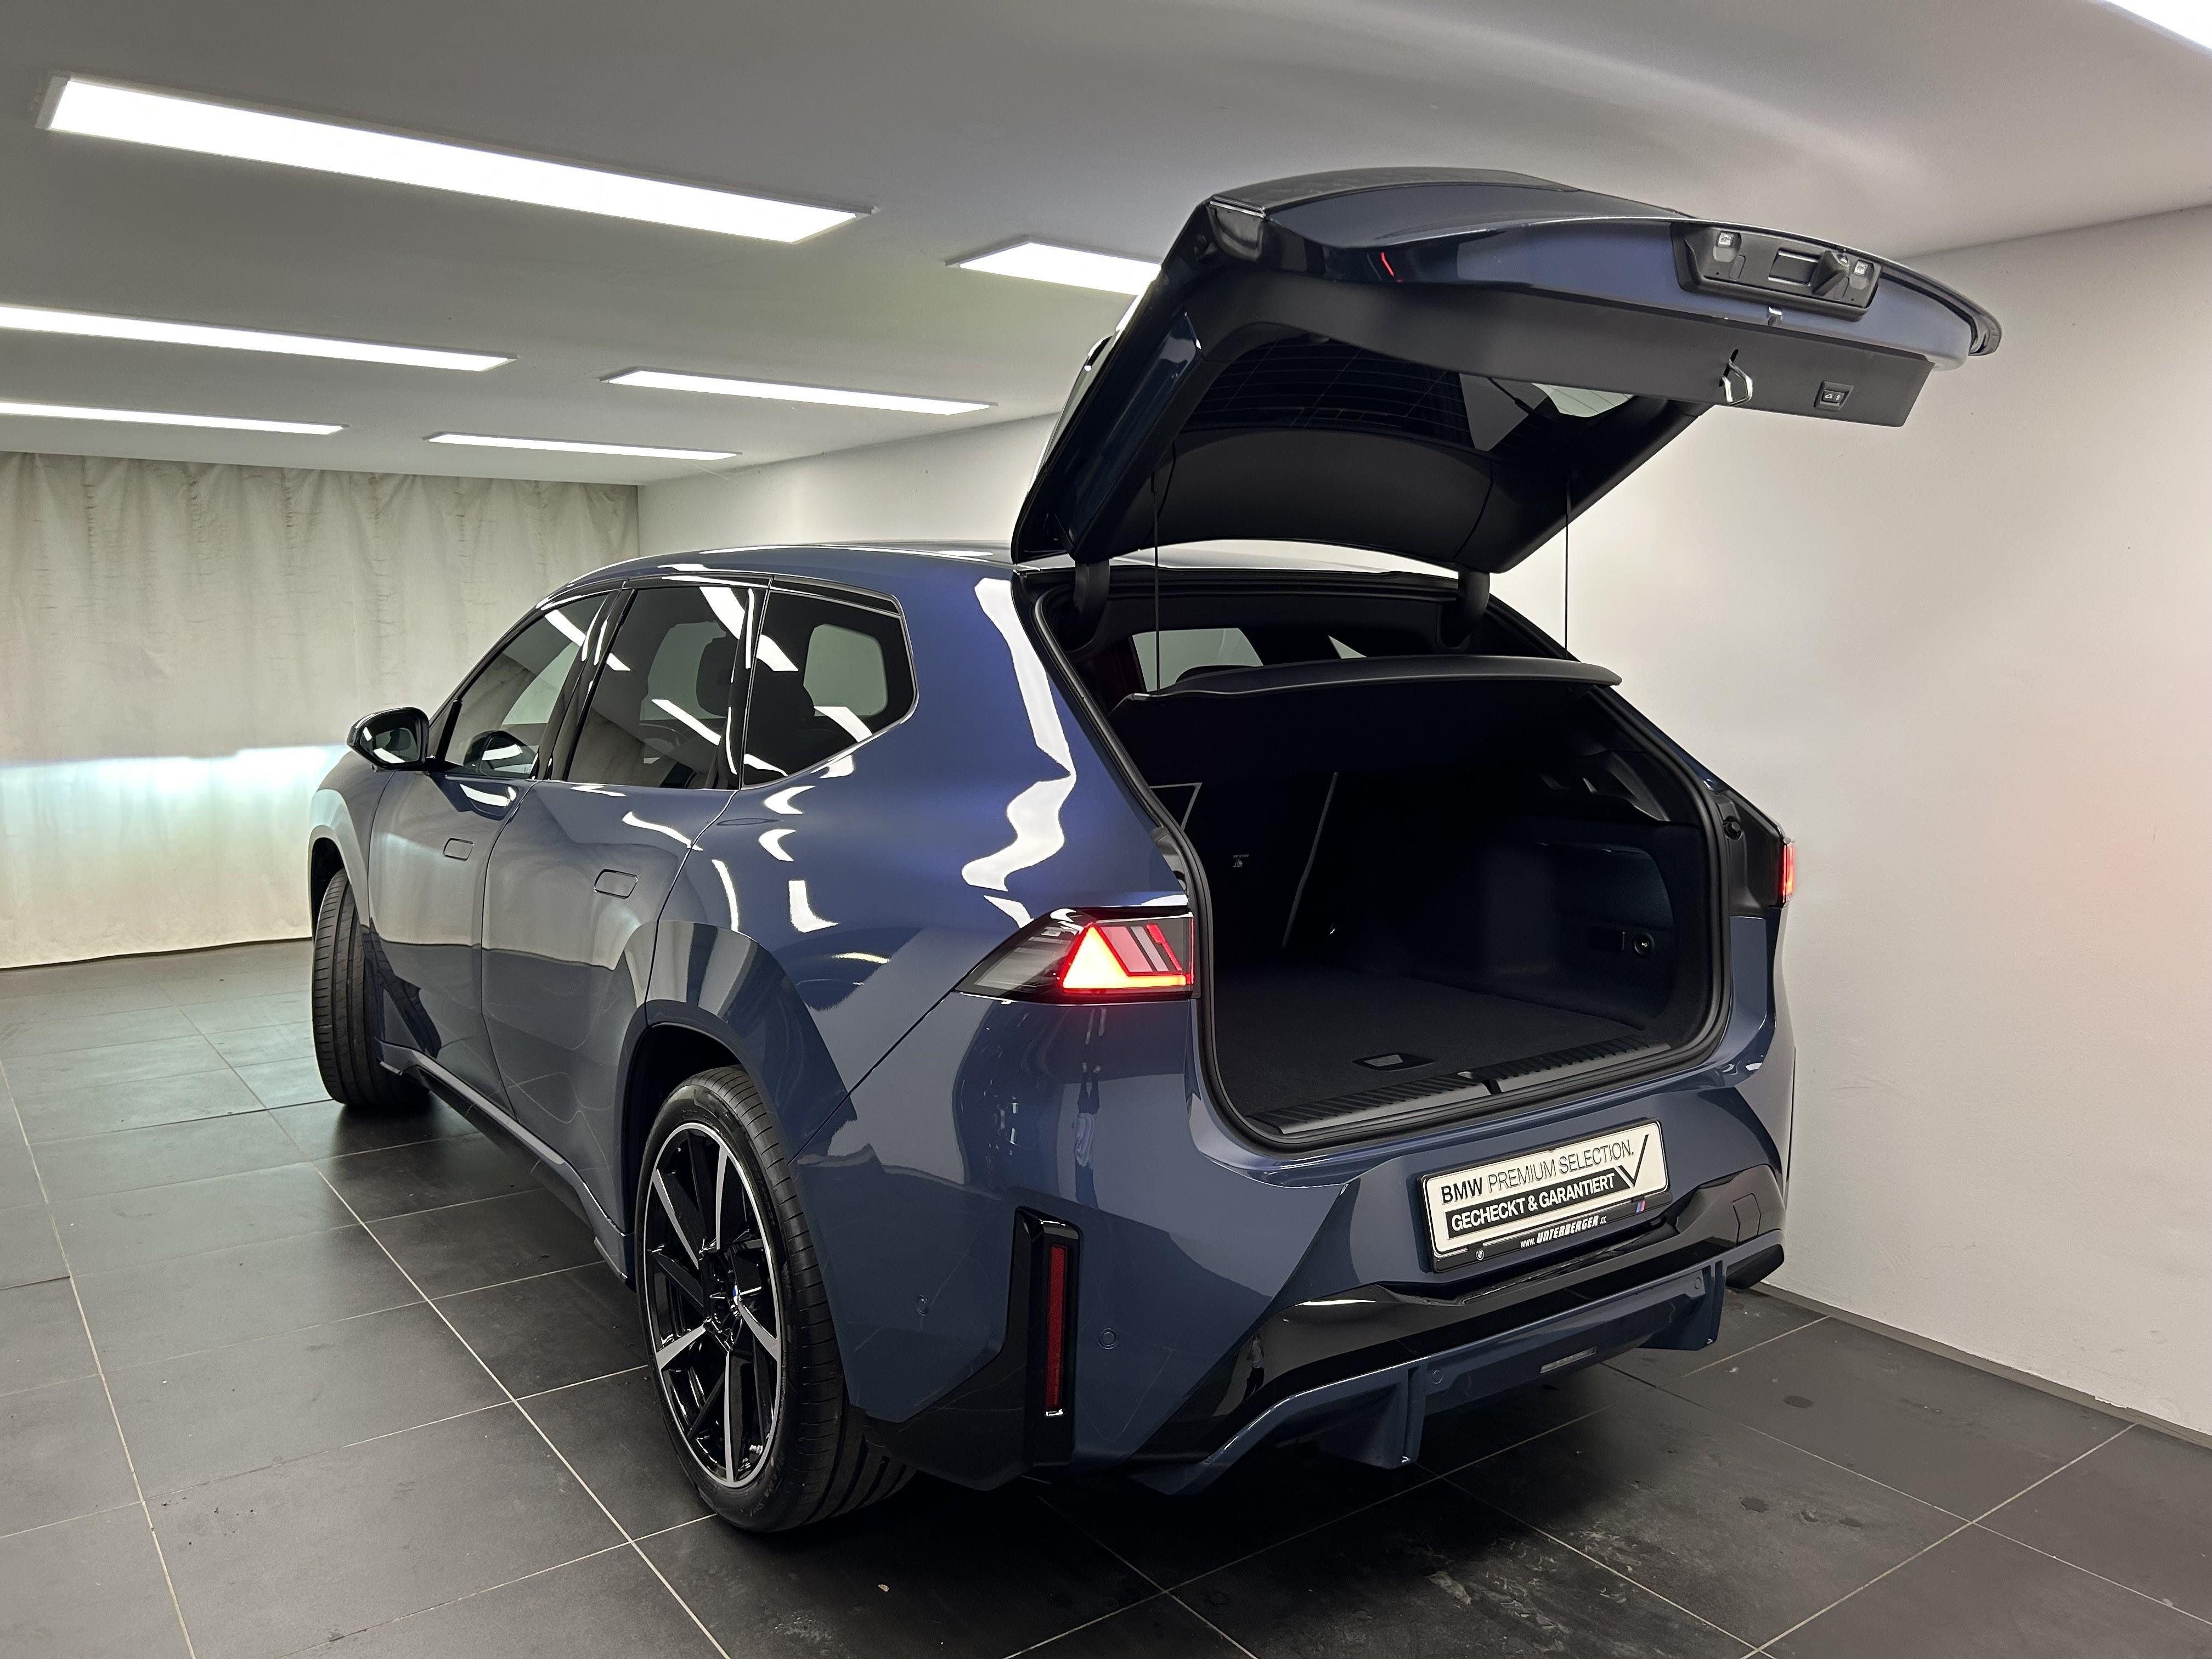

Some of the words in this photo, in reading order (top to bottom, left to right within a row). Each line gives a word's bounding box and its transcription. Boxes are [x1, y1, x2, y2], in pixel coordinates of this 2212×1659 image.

[1441, 1177, 1482, 1204] BMW
[1488, 1159, 1556, 1193] PREMIUM
[1559, 1139, 1634, 1174] SELECTION.
[1452, 1197, 1526, 1231] GECHECKT
[1528, 1195, 1538, 1211] &
[1539, 1172, 1615, 1207] GARANTIERT
